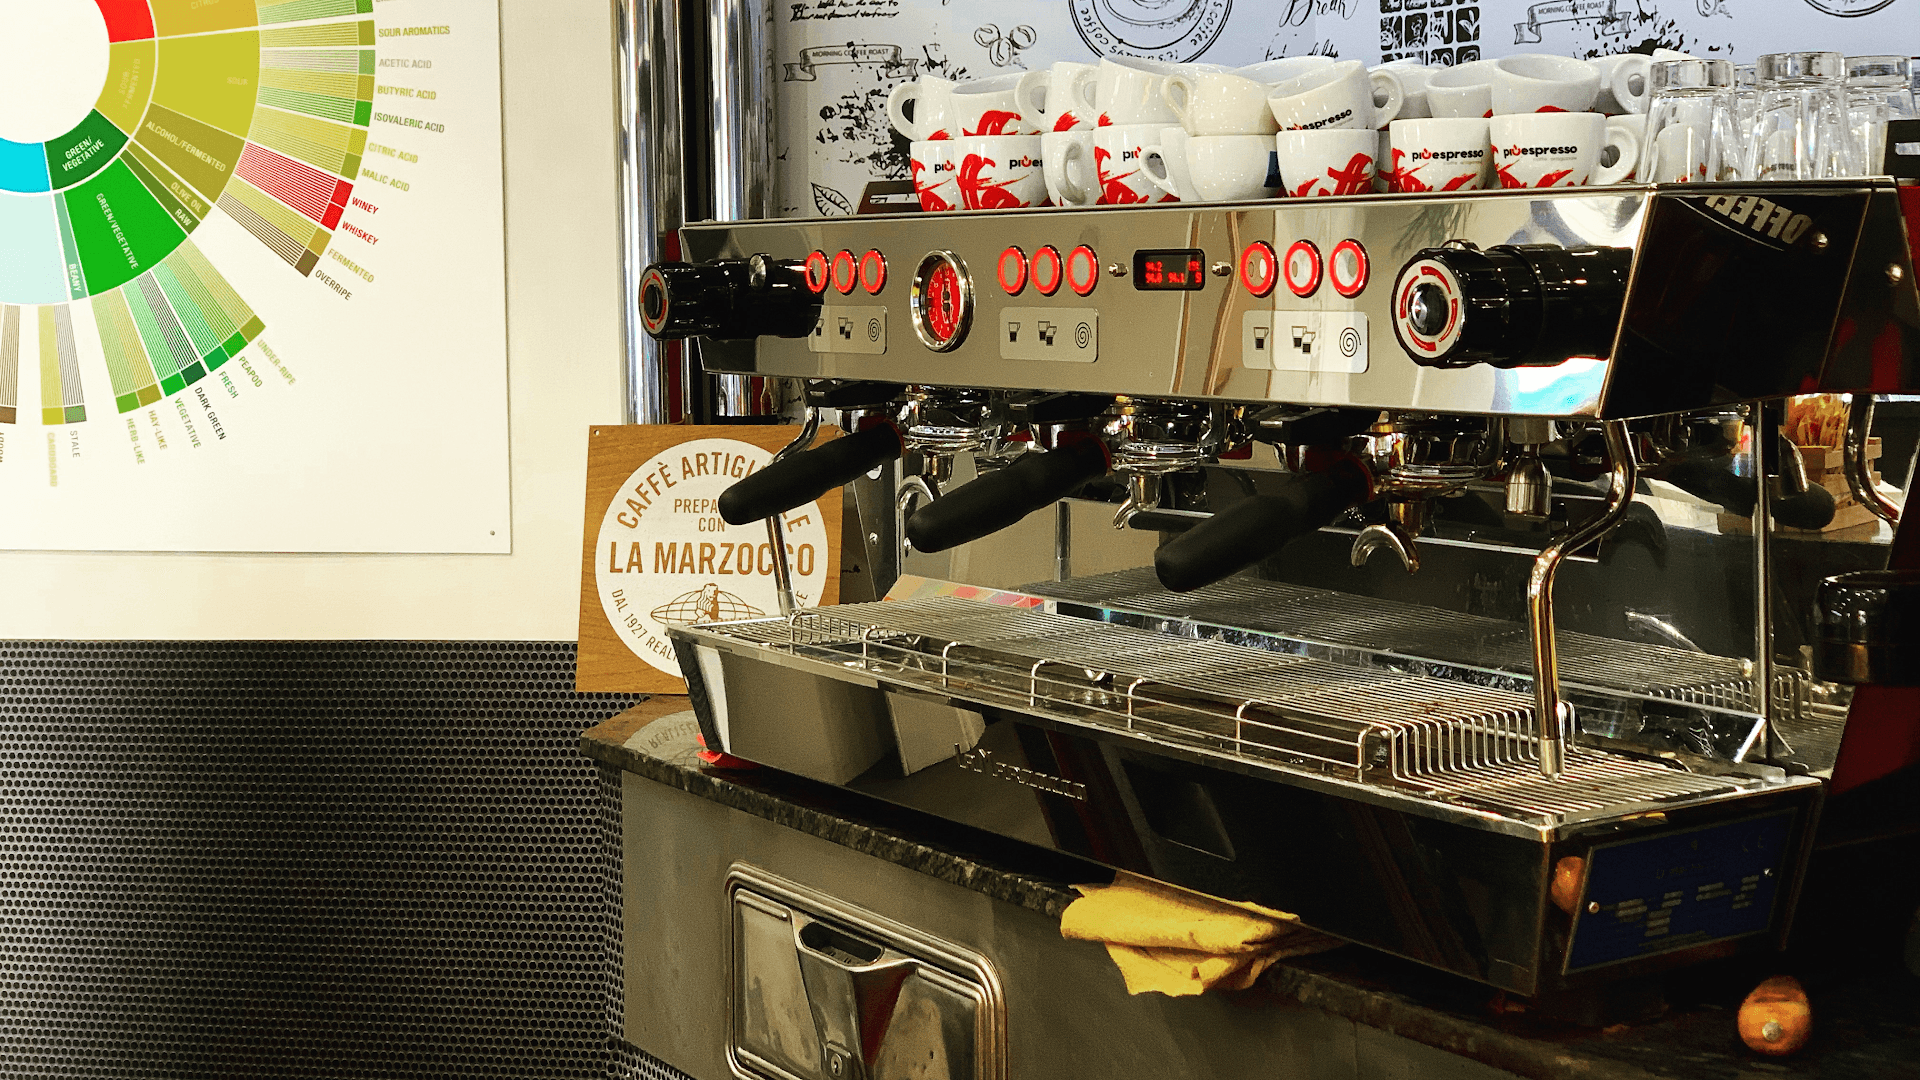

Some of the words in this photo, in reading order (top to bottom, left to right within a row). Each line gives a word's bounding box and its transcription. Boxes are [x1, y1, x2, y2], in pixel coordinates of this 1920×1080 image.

[1565, 4, 1585, 13] COFEE
[378, 28, 401, 38] SOUR
[402, 25, 451, 36] AROMATICS
[378, 58, 410, 68] ACETIC
[411, 59, 432, 69] ACID
[811, 50, 843, 58] MORNING
[844, 49, 867, 57] COFEE
[868, 48, 889, 56] ROAST
[377, 85, 415, 98] BUTYRIC
[416, 89, 437, 101] ACID
[374, 112, 423, 129] ISOVALERIC
[424, 121, 445, 133] ACID
[62, 138, 105, 172] VEGETATIVE
[65, 135, 93, 160] GREEN/
[145, 120, 227, 172] ALCOHOL/FERMENTED
[368, 142, 396, 158] CITRIC
[397, 151, 419, 164] ACID
[361, 167, 388, 184] MALIC
[389, 178, 410, 192] ACID
[170, 181, 192, 203] OLIVE
[190, 199, 203, 213] OIL
[351, 196, 379, 215] WINEY
[174, 207, 193, 227] RAW
[96, 193, 139, 270] GREEN/VEGETATIVE
[342, 220, 379, 245] WHISKEY
[68, 263, 82, 292] BEANY
[327, 248, 375, 283] FERMENTED
[315, 270, 352, 301] OVERRIPE
[238, 356, 263, 388] PEAPOD
[257, 339, 296, 386] UNDER-RIPE
[219, 371, 239, 399] FRESH
[174, 397, 202, 449] VEGETATIVE
[194, 386, 212, 411] DARK
[207, 411, 227, 440] GREEN
[148, 409, 168, 450] HAY-LIKE
[69, 430, 81, 458] STALE
[616, 461, 677, 530] CAFFÈ
[698, 517, 726, 532] CON
[609, 541, 644, 574] LA
[611, 588, 629, 613] DAL
[624, 613, 648, 639] 1927
